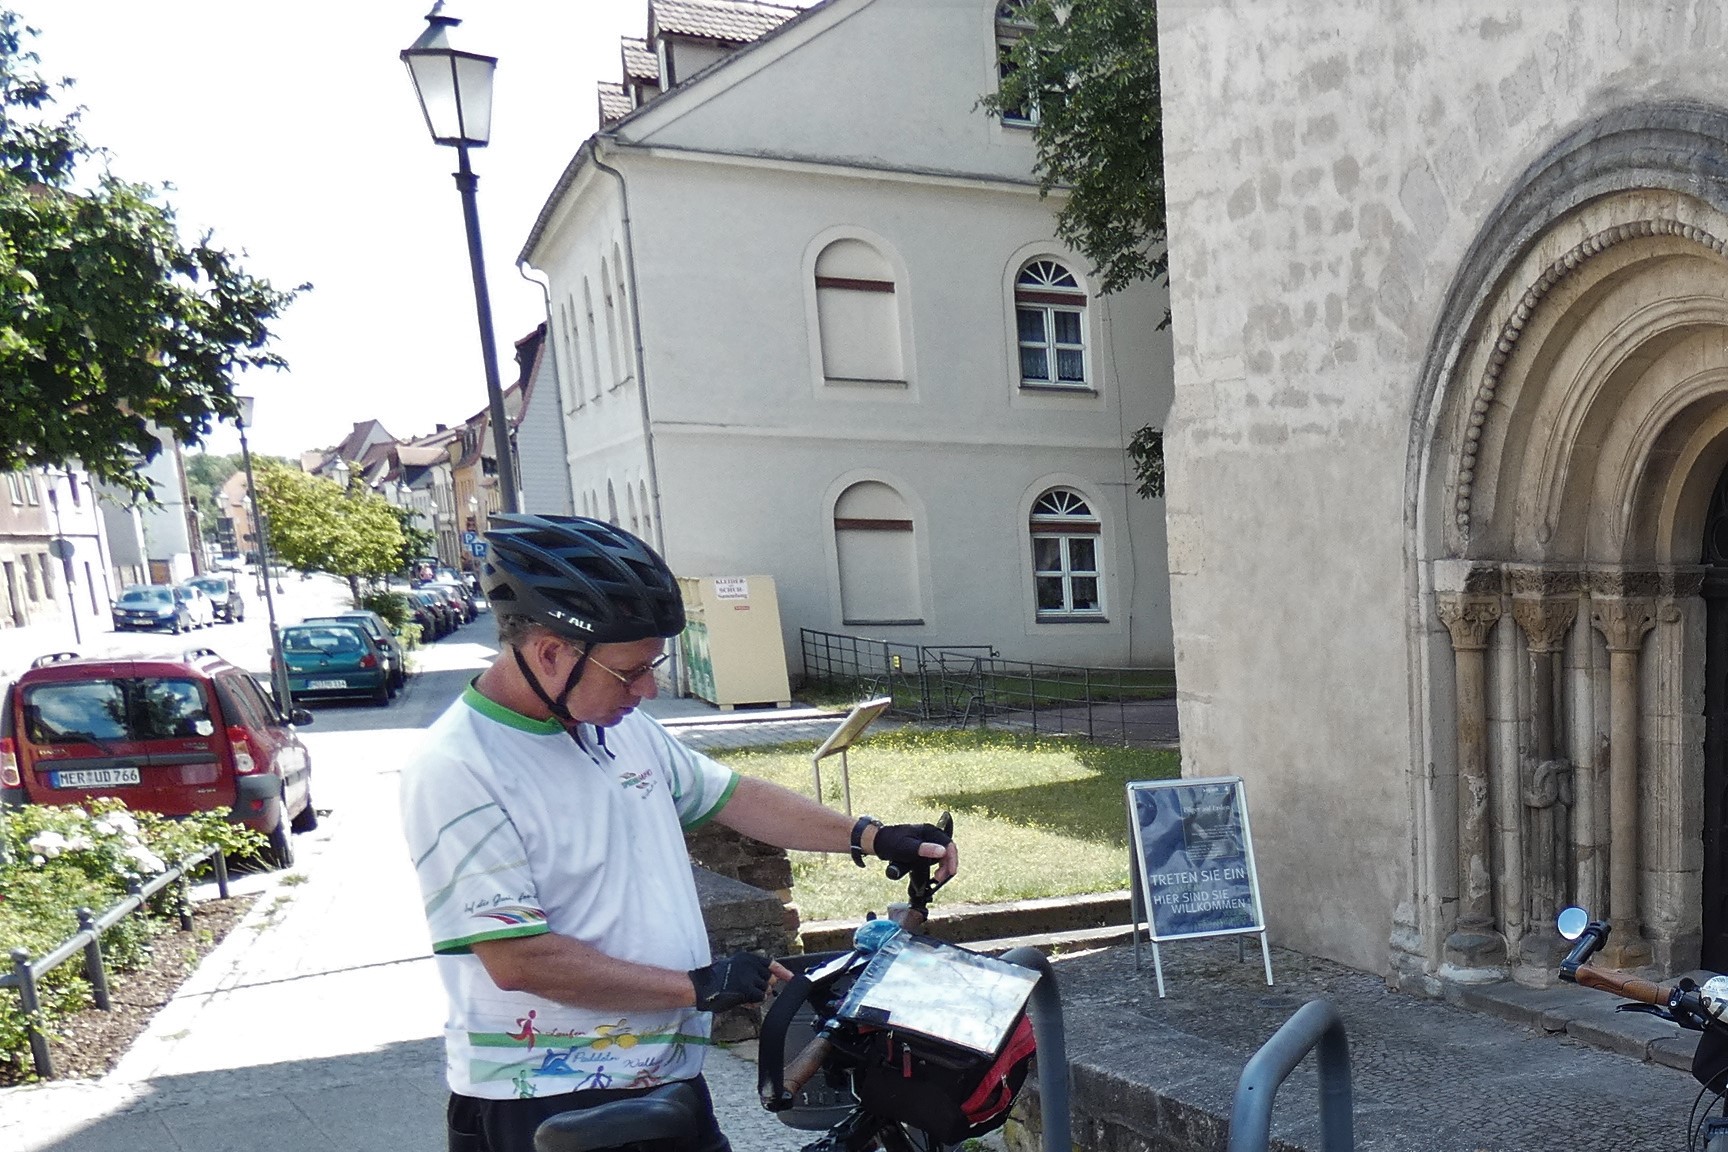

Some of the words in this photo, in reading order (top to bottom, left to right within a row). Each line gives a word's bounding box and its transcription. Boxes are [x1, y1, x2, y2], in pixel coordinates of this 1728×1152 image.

[465, 533, 474, 543] P
[475, 544, 484, 556] P
[59, 771, 86, 785] MER
[95, 770, 111, 784] UD
[115, 769, 138, 783] 766
[1150, 871, 1198, 886] TRETEN
[1200, 869, 1221, 882] SIE
[1223, 867, 1245, 880] EIN
[1153, 893, 1180, 905] HIER
[1182, 891, 1209, 903] SIND
[1212, 889, 1229, 900] SIE
[1170, 898, 1246, 914] WILLKOMMEN
